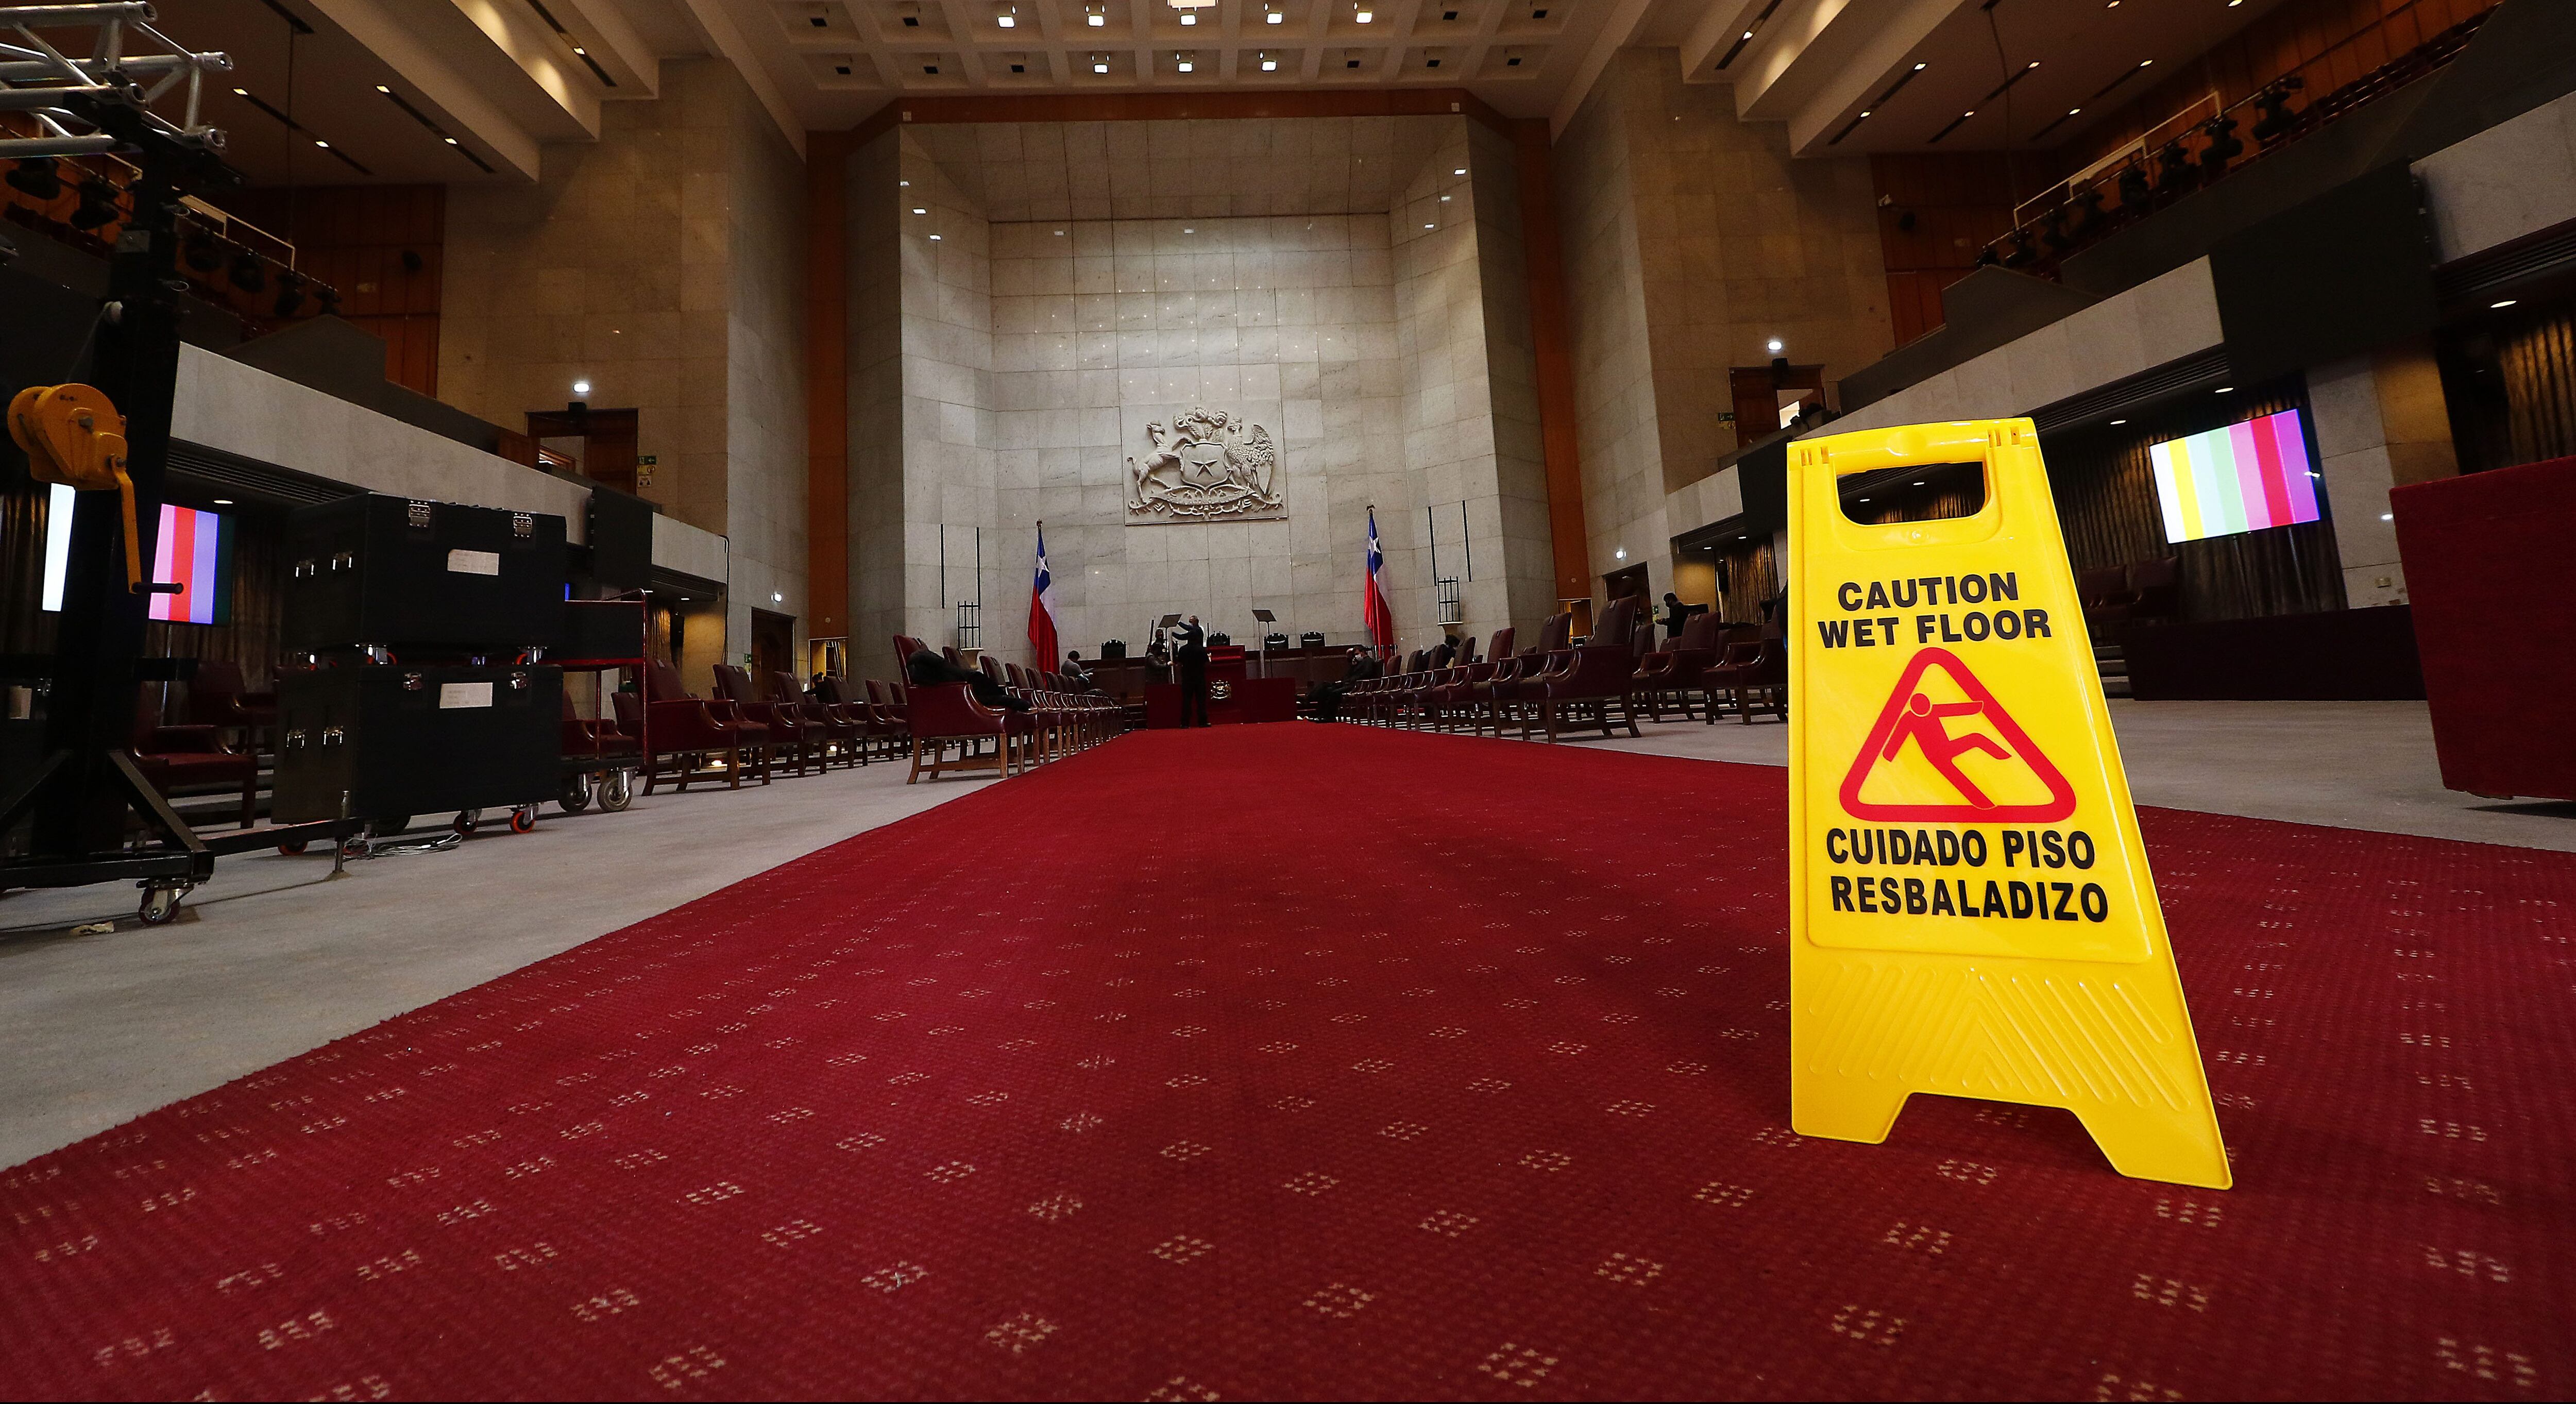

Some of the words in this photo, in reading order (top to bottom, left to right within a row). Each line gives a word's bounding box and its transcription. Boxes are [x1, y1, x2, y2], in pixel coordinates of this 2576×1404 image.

[1838, 572, 2019, 612] CAUTION
[1817, 617, 1899, 649] WET
[1916, 609, 2052, 644] FLOOR
[1826, 828, 1987, 867] CUIDADO
[2002, 830, 2095, 870] PISO
[1831, 875, 2108, 923] RESBALADIZO
